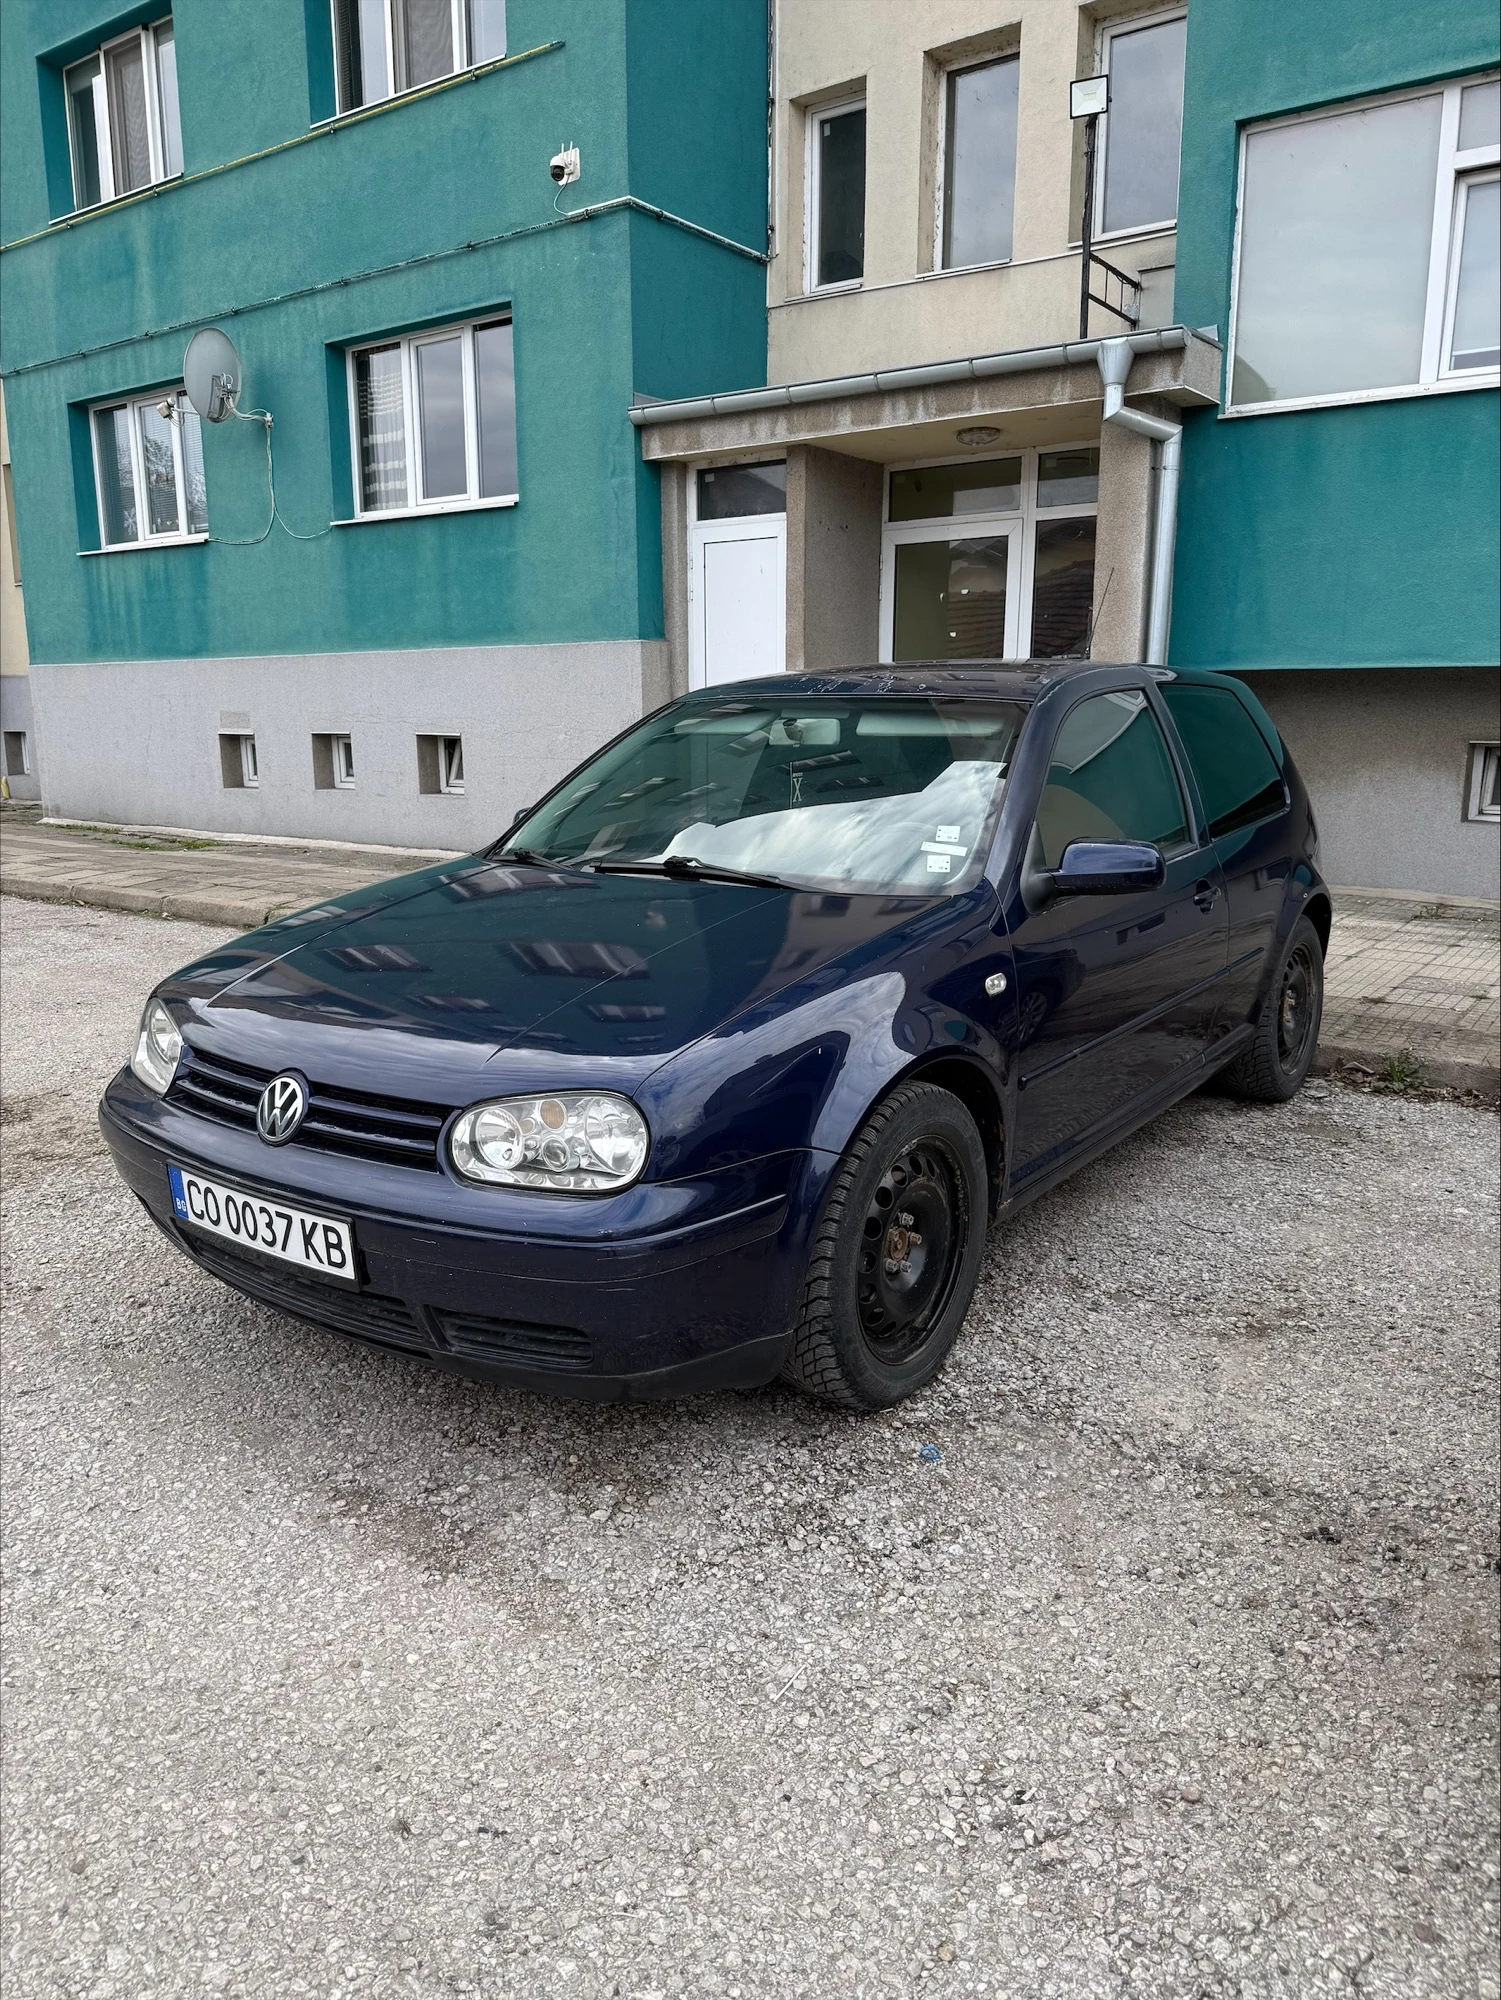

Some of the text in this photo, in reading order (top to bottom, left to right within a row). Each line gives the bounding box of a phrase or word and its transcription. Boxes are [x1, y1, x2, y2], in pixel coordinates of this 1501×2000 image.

[258, 1076, 304, 1141] VW
[176, 1197, 187, 1212] BG
[187, 1179, 347, 1269] CO 0037 KB
